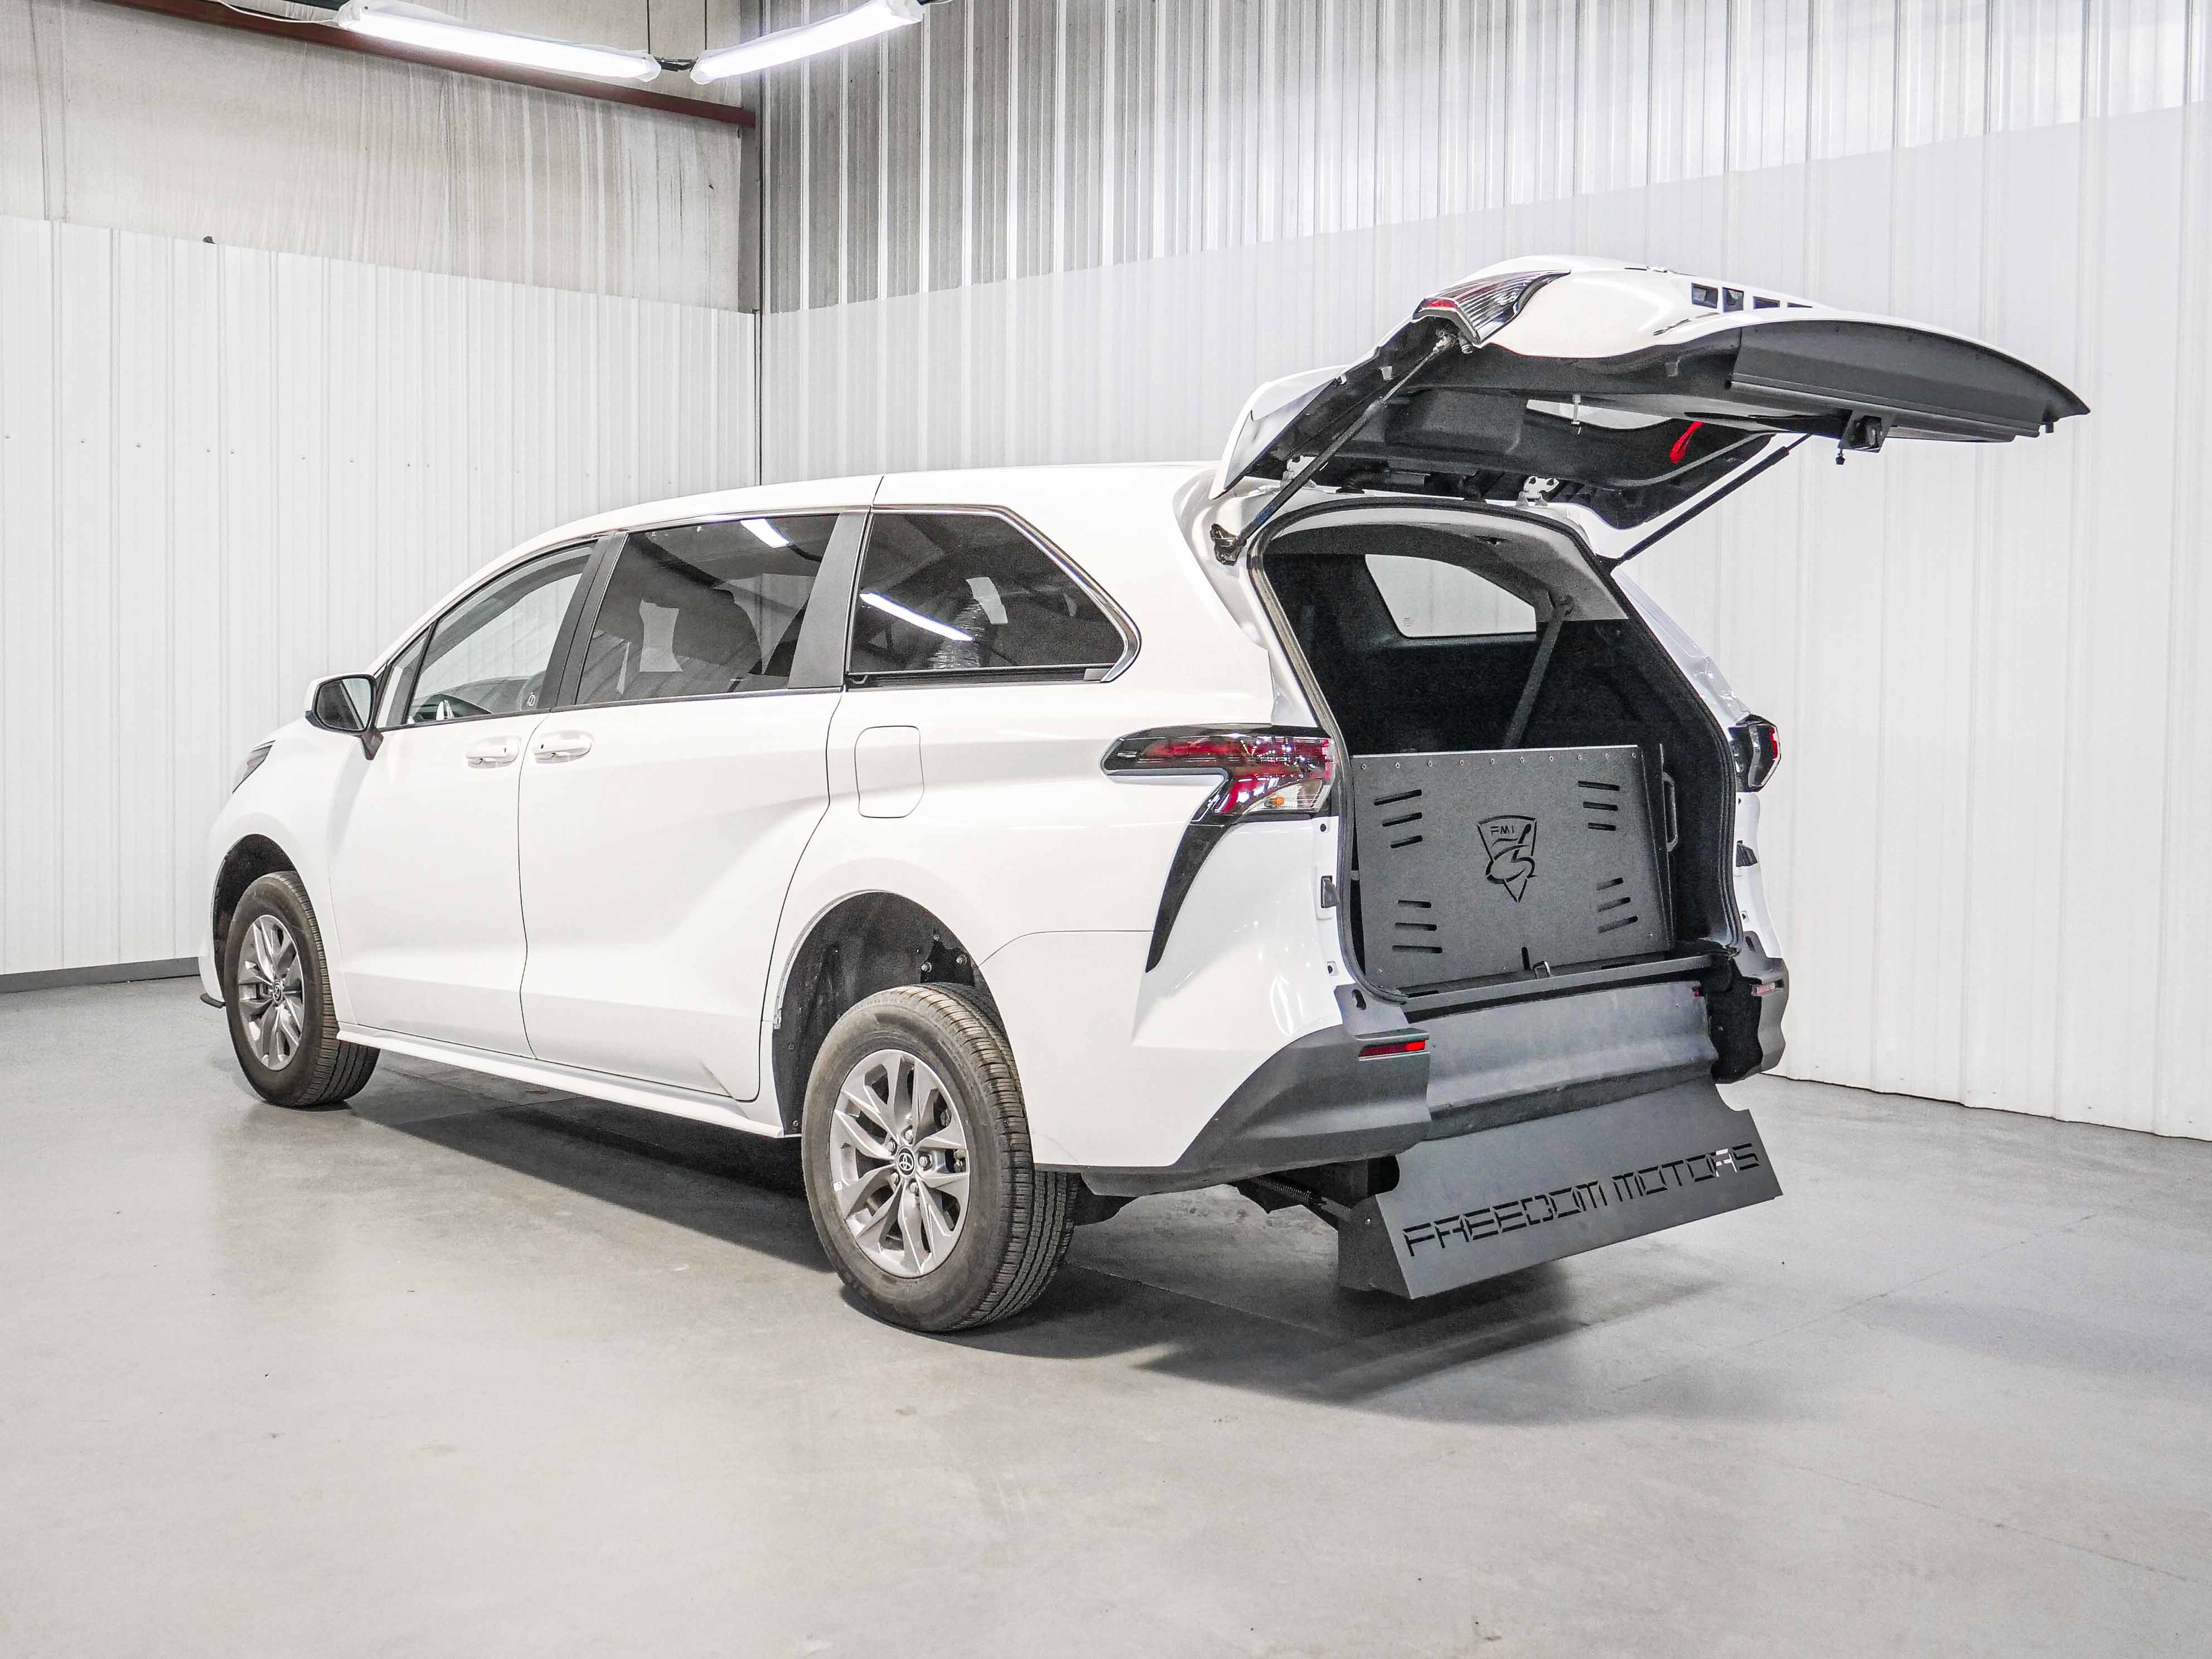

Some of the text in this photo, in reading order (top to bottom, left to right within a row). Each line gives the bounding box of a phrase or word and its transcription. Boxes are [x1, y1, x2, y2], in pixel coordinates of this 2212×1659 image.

[1490, 825, 1514, 835] FMI
[1403, 1143, 1760, 1257] FREEDOM MOTORS
